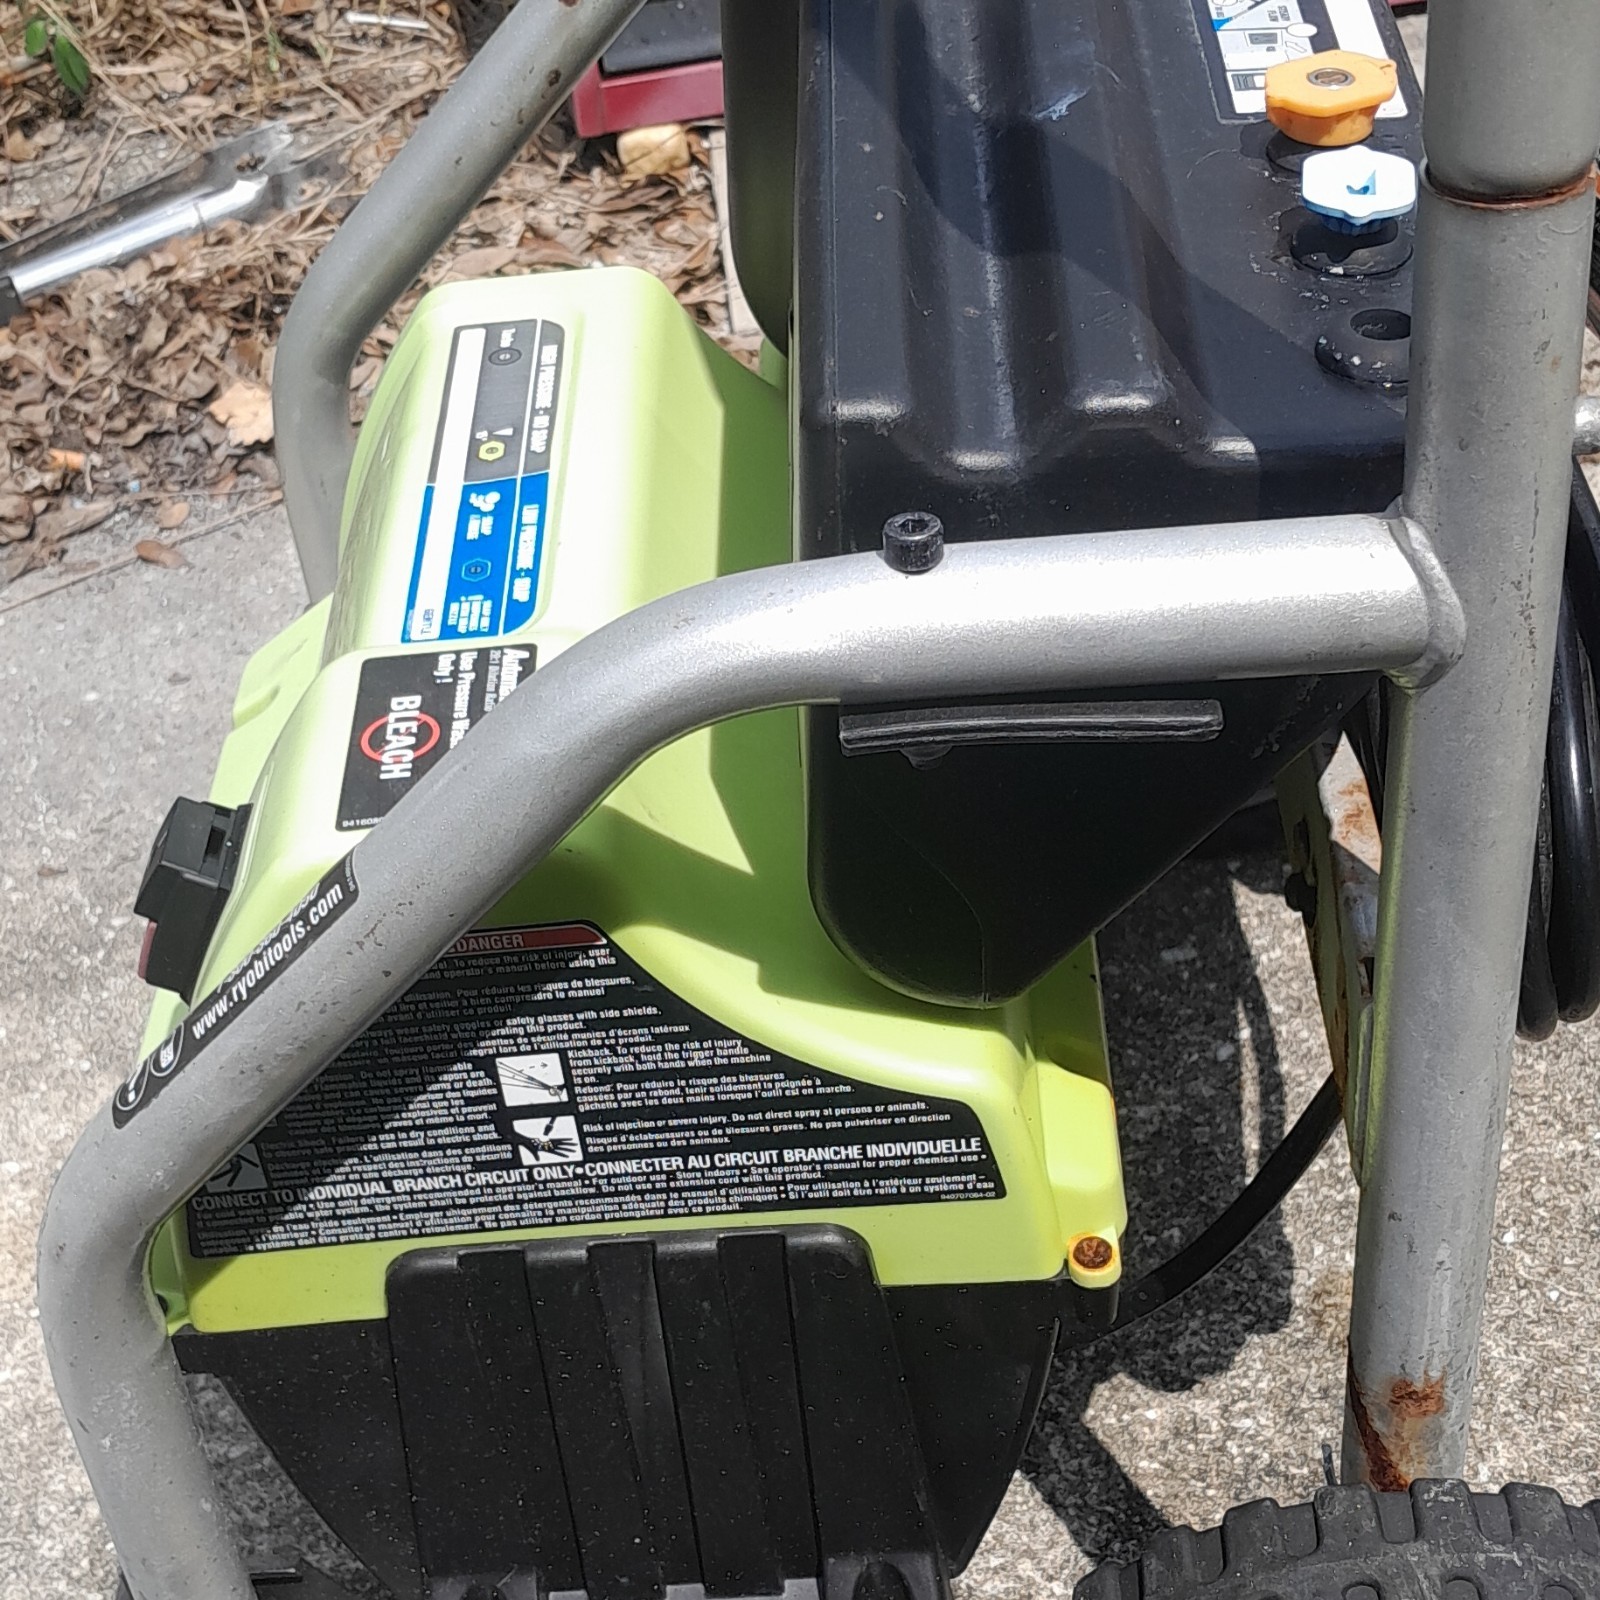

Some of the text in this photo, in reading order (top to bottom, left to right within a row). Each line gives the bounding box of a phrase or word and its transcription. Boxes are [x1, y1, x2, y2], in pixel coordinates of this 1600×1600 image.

[433, 653, 456, 677] Only
[459, 651, 478, 670] Use
[499, 649, 530, 705] Automa
[453, 673, 476, 719] Pressure
[379, 694, 422, 780] BLEACH
[449, 719, 471, 750] Was
[192, 883, 343, 1039] www.ryobitools.com
[461, 934, 523, 952] DANGER
[191, 1190, 266, 1210] CONNECT
[268, 1188, 294, 1204] TO
[392, 1173, 462, 1193] BRANCH
[464, 1168, 528, 1187] CIRCUIT
[687, 1154, 710, 1169] AU
[713, 1149, 777, 1168] CIRCUIT
[782, 1142, 862, 1163] BRANCHE
[866, 1134, 980, 1157] INDIVIDUELLE
